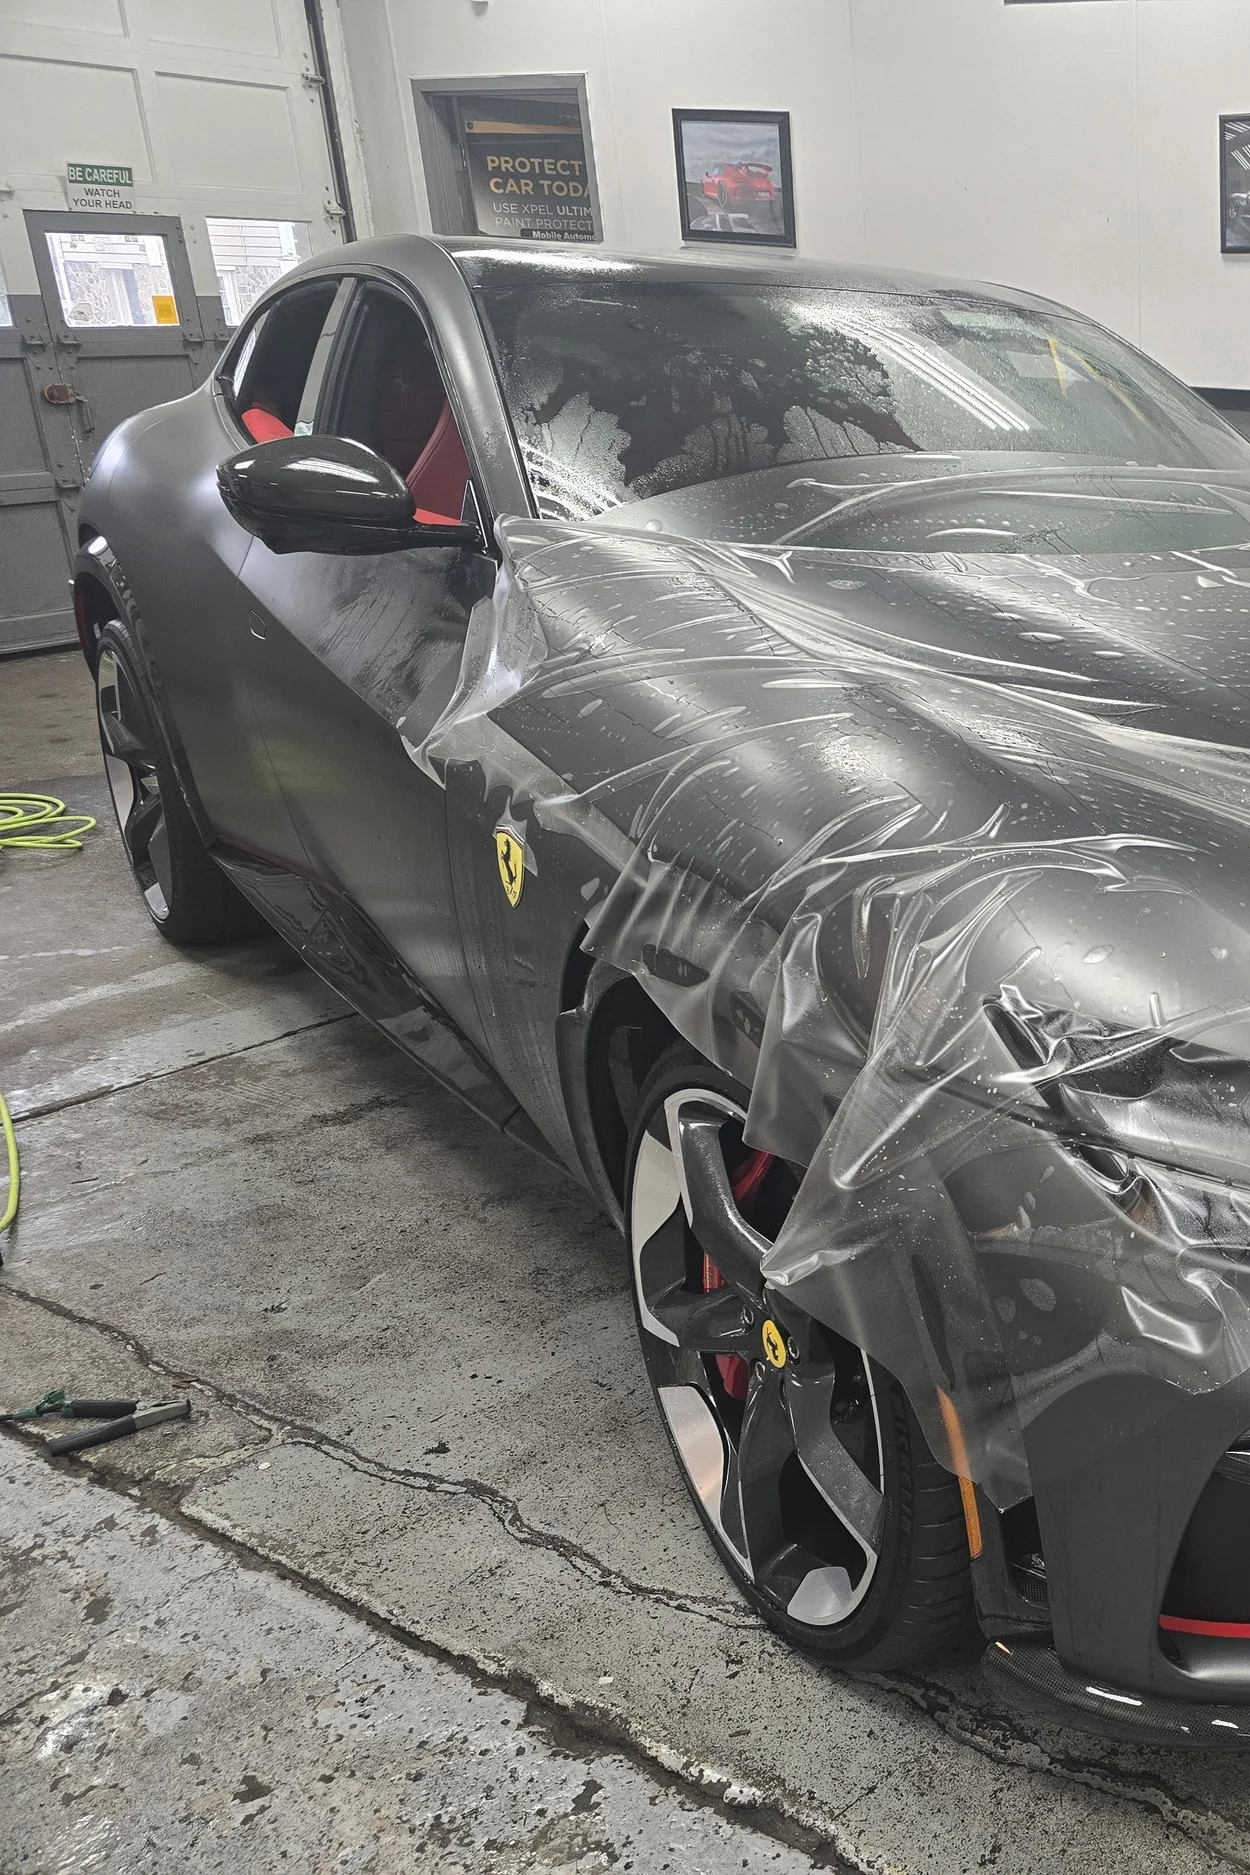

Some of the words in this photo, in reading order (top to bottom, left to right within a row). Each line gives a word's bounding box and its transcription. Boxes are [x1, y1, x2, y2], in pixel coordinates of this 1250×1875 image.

[486, 156, 582, 176] PROTECT
[69, 166, 84, 181] BE
[85, 168, 132, 184] CAREFUL
[84, 187, 120, 198] WATCH
[489, 177, 534, 195] CAR
[72, 198, 102, 208] YOUR
[105, 200, 132, 209] HEAD
[493, 203, 518, 214] USE
[522, 204, 553, 216] XPEL
[495, 217, 531, 229] PAINT
[536, 219, 593, 231] PROTECT
[532, 231, 562, 240] Mobile
